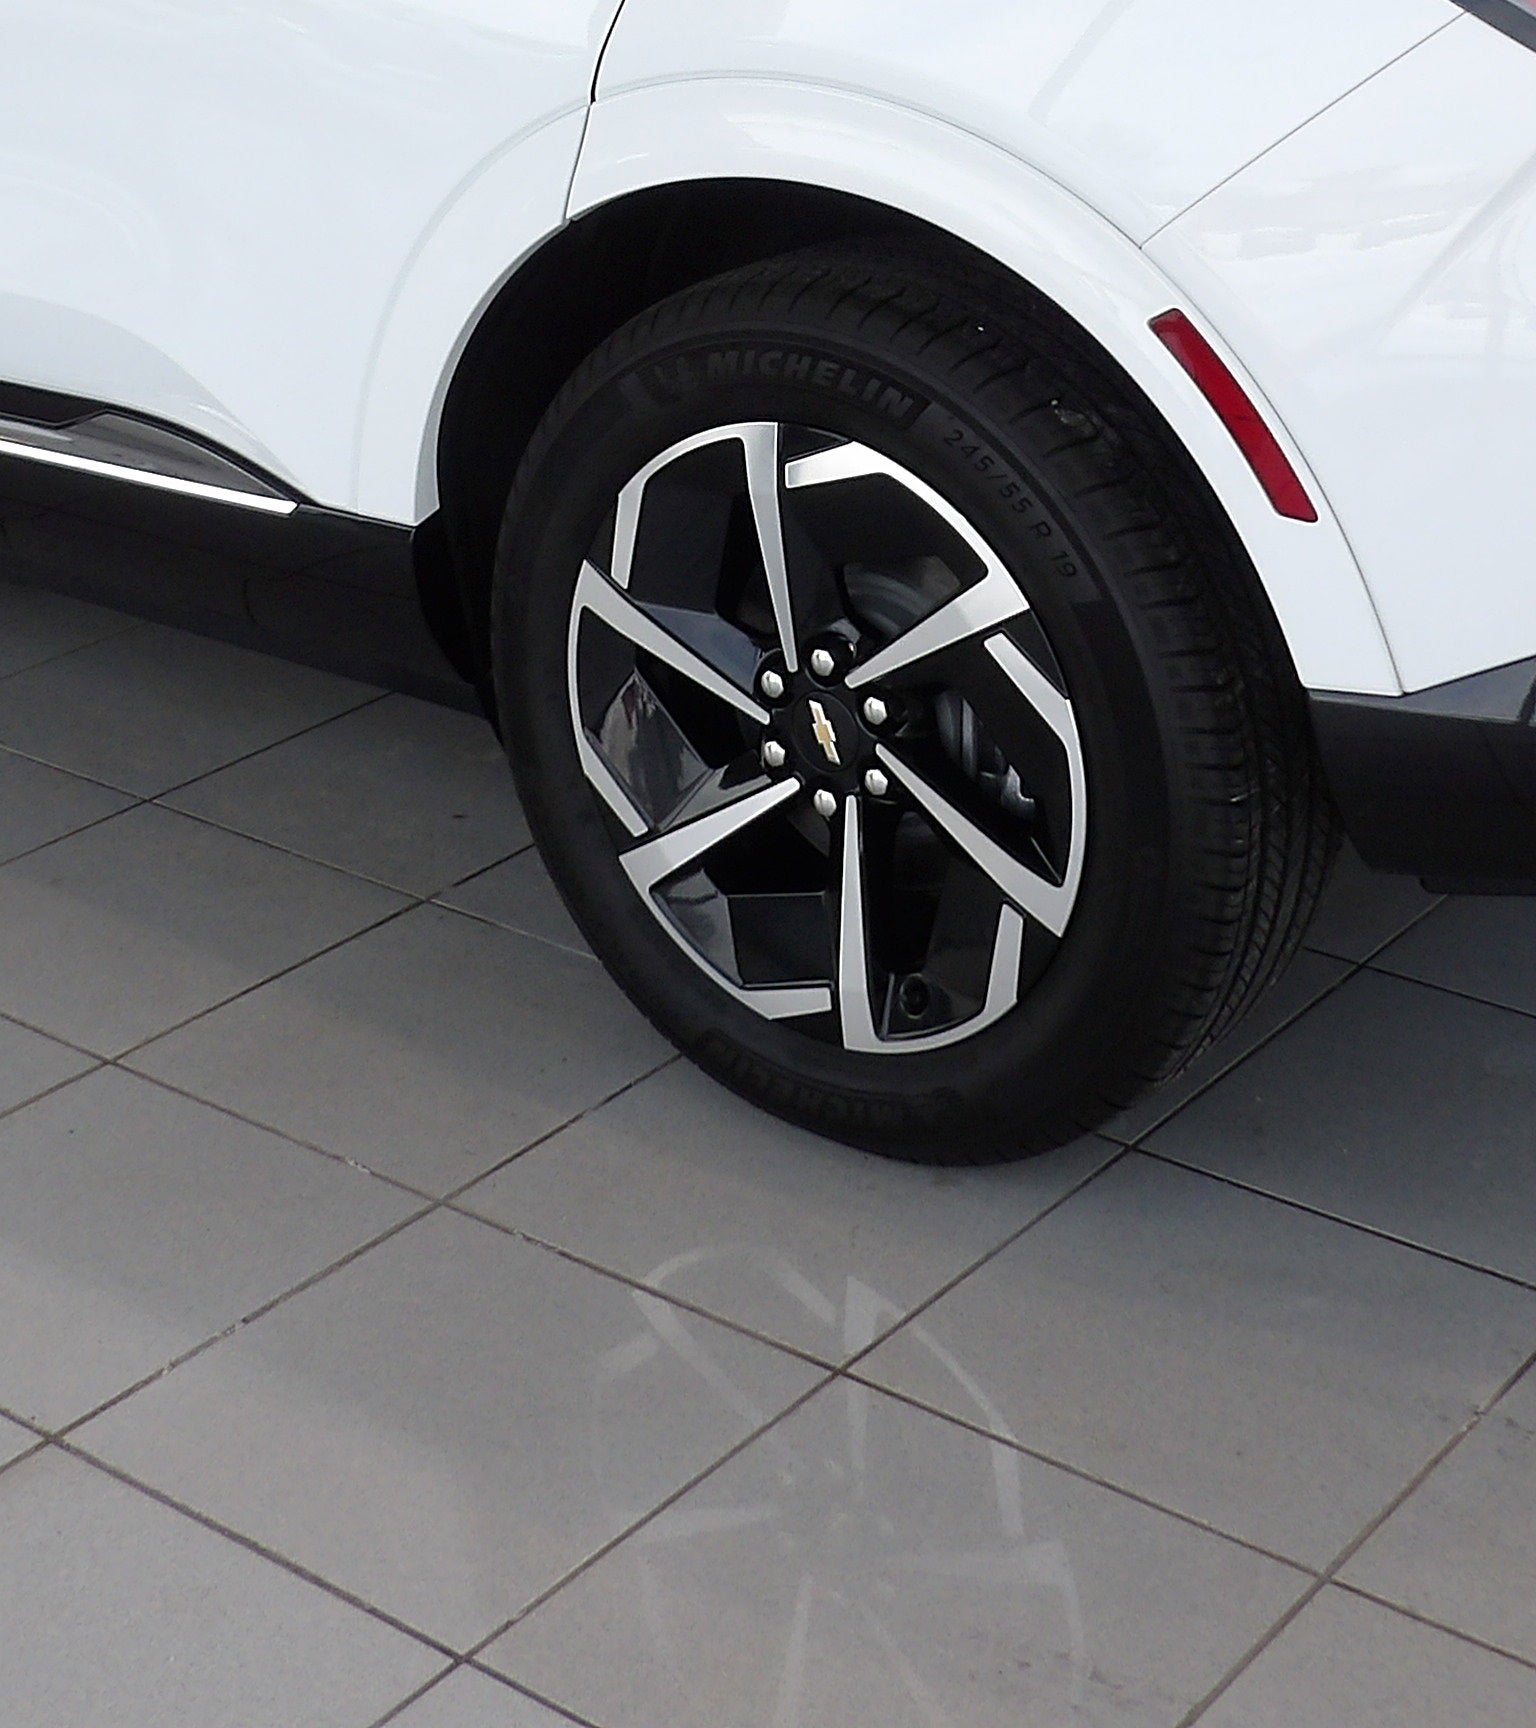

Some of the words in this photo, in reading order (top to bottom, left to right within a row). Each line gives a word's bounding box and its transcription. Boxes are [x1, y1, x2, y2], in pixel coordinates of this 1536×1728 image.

[707, 348, 915, 419] MICHELIN
[944, 428, 1034, 514] 245/55
[1028, 520, 1053, 538] R
[1050, 550, 1078, 578] 19
